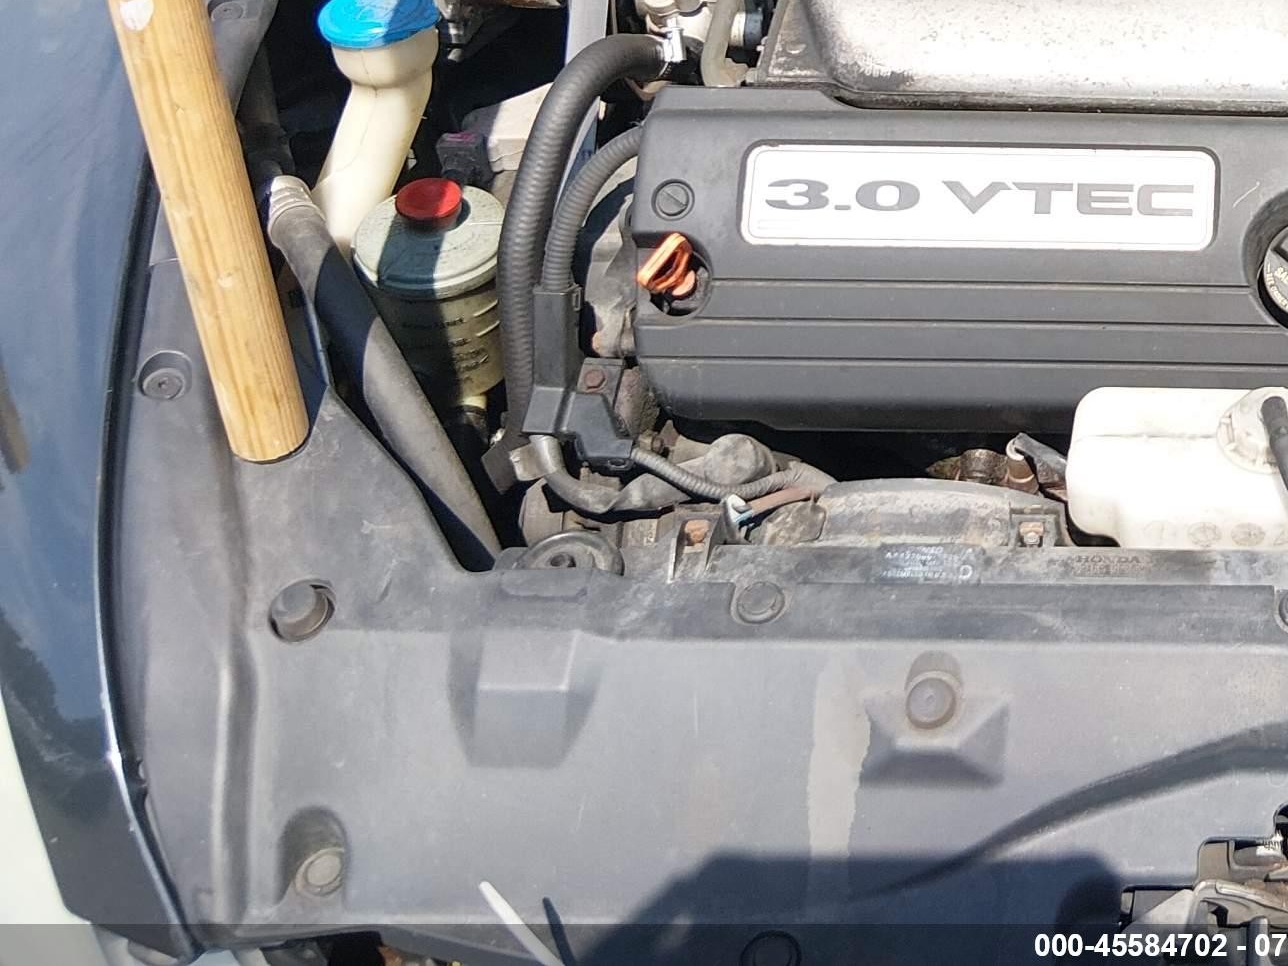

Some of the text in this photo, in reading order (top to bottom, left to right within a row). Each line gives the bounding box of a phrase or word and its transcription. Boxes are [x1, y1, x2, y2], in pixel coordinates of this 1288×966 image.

[766, 178, 1195, 217] 3.0 VTEC
[1075, 554, 1142, 565] HONDA
